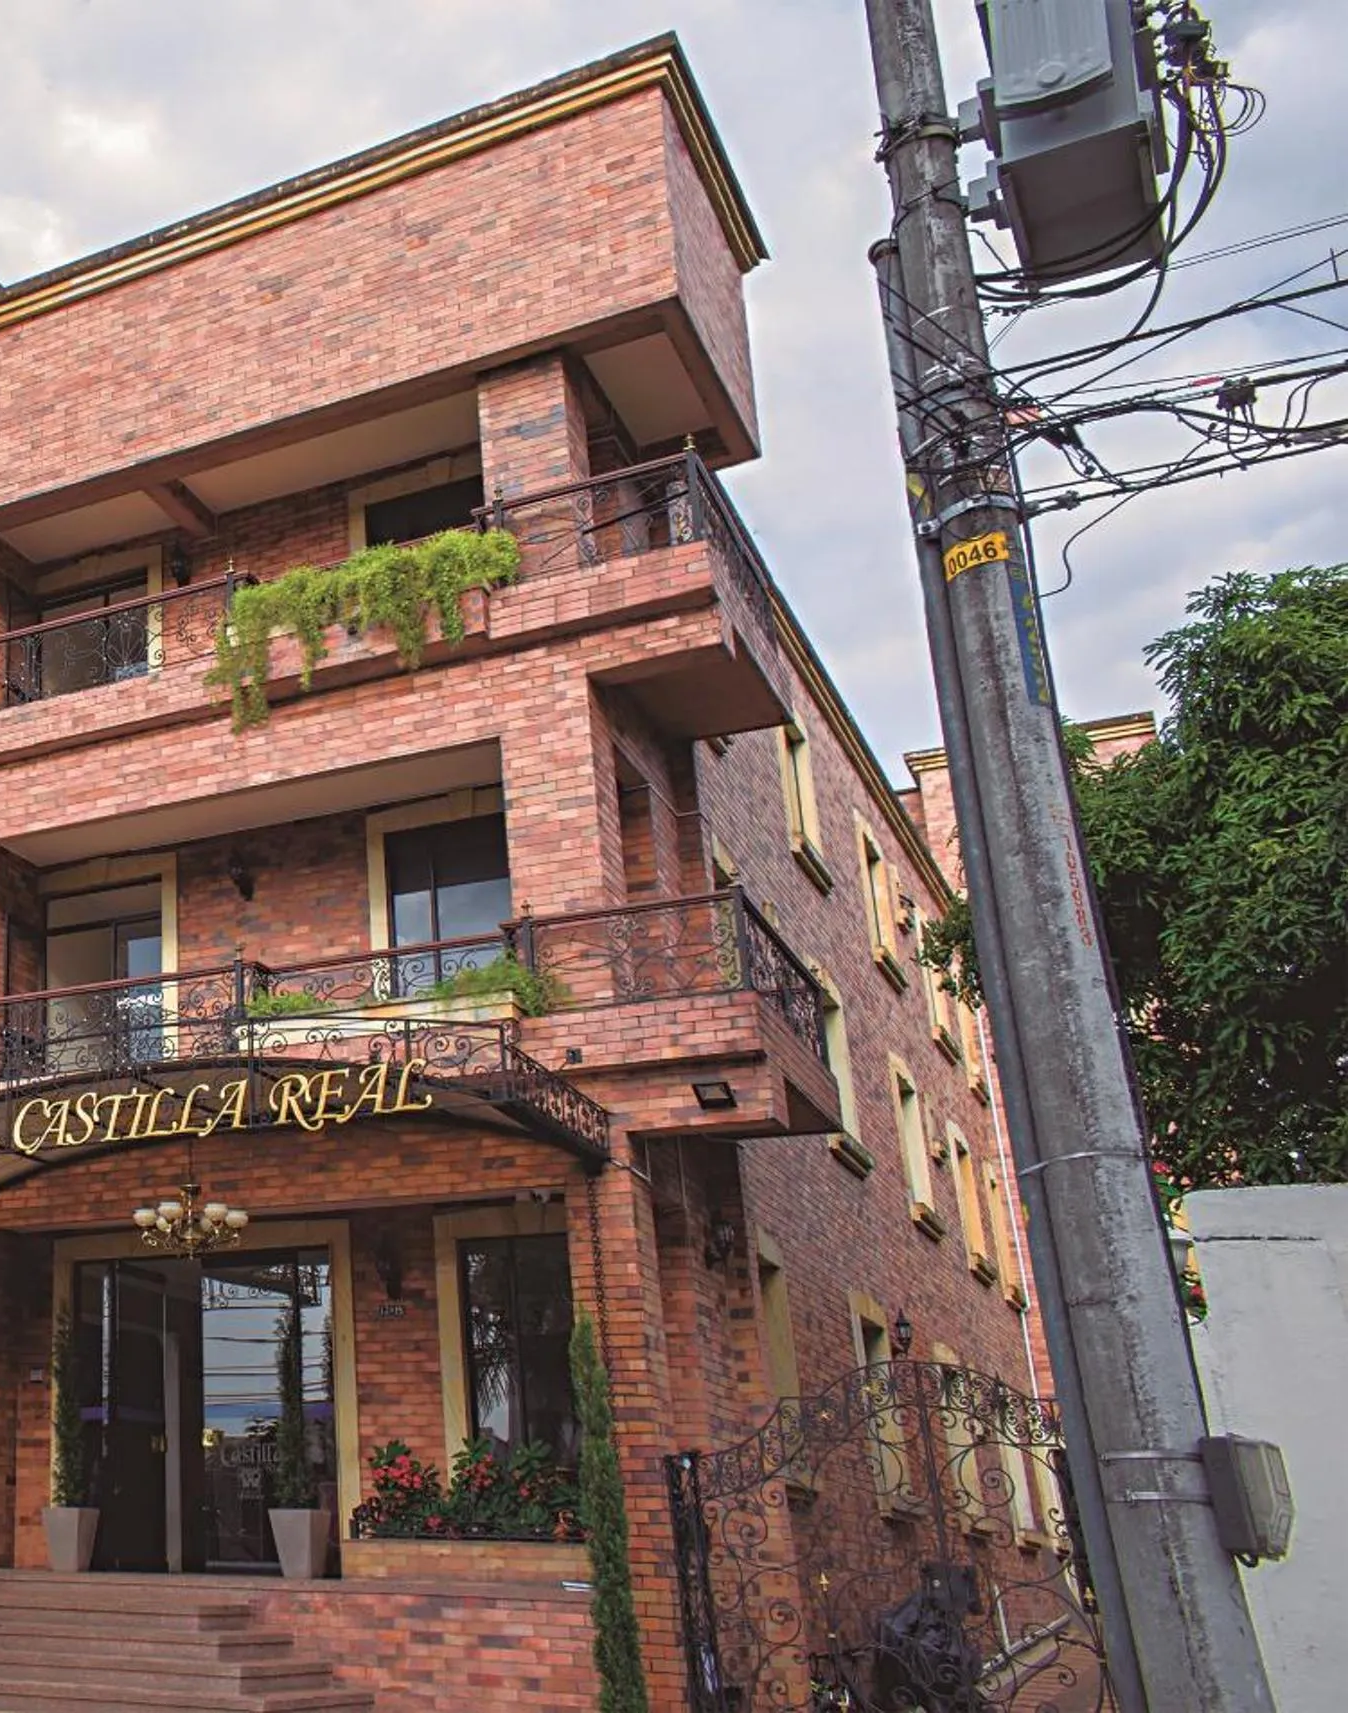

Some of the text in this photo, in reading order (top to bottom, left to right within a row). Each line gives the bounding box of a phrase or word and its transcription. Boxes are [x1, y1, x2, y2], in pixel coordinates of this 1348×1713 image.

[948, 541, 998, 575] 0046
[13, 1079, 249, 1155] CASTILLA
[268, 1058, 433, 1131] REAL
